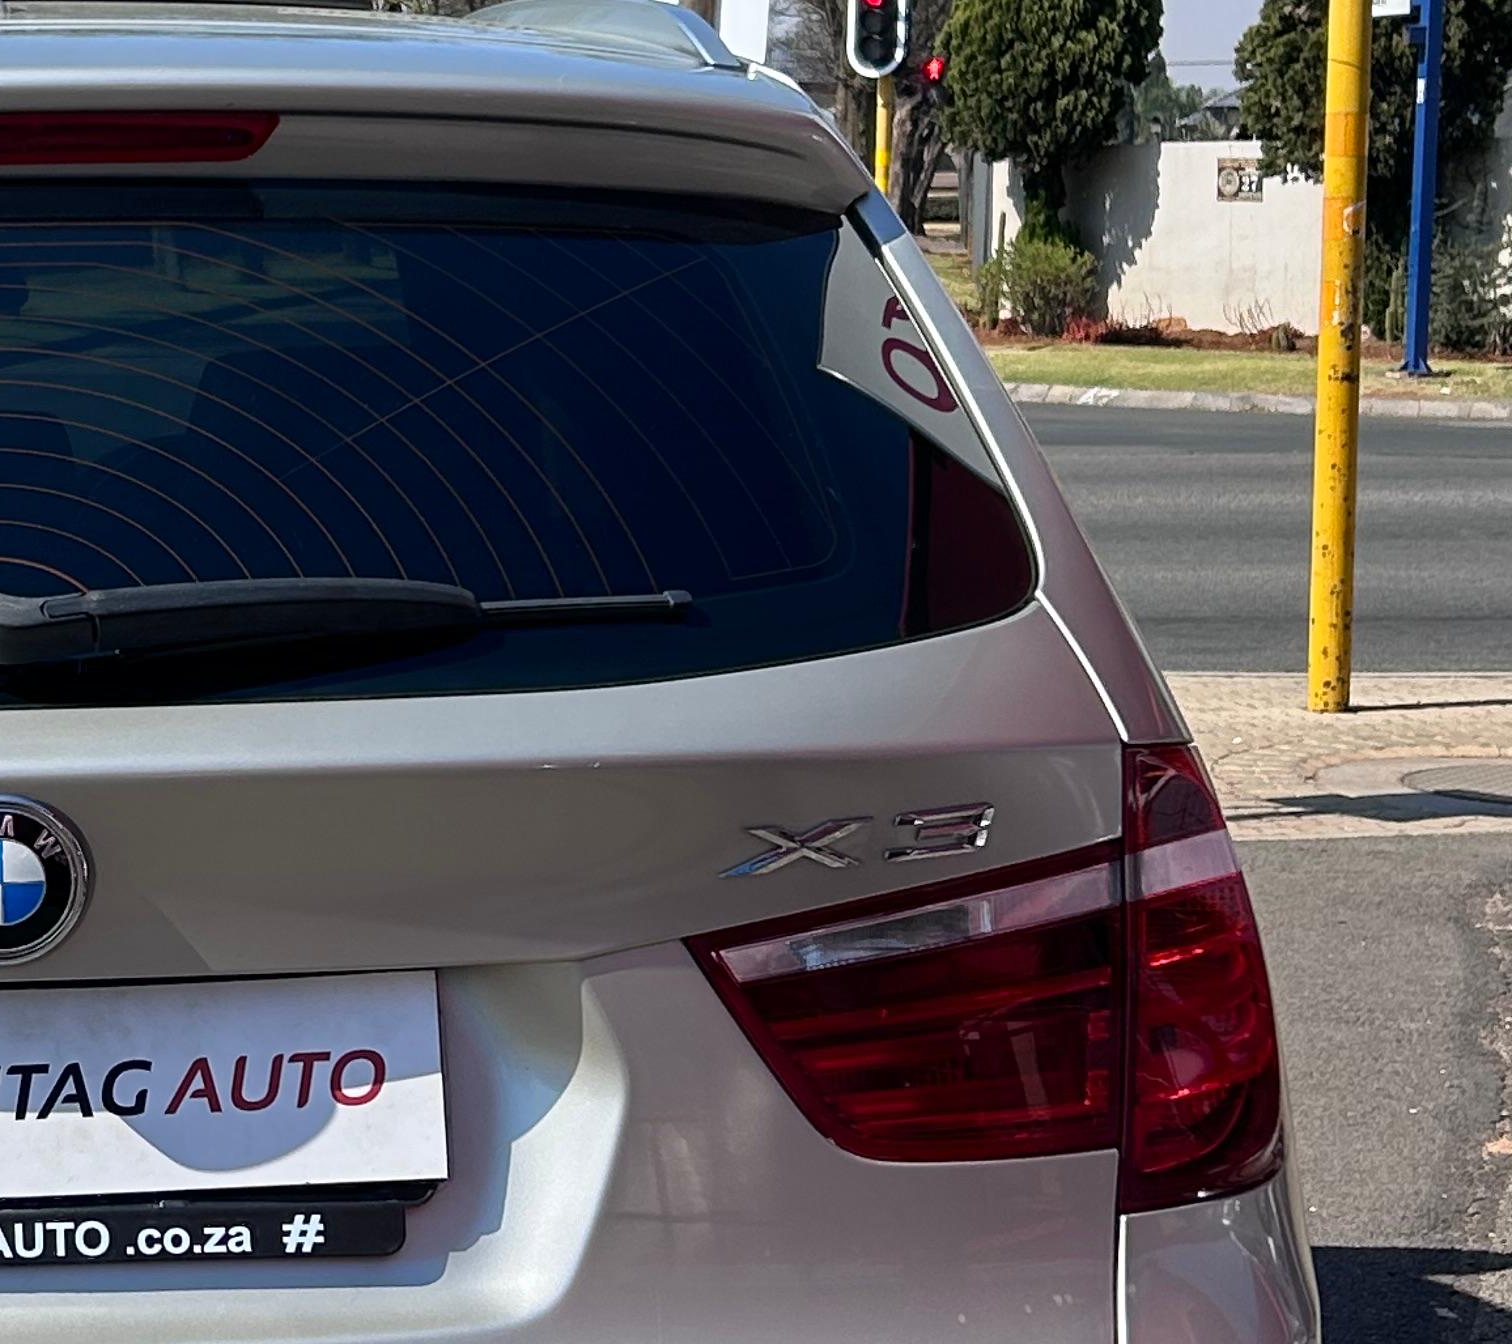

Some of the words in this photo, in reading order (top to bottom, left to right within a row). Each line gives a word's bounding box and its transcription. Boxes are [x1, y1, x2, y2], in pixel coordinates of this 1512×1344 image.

[718, 802, 995, 878] X3
[164, 1048, 387, 1115] AUTO
[125, 1223, 252, 1256] .co.za
